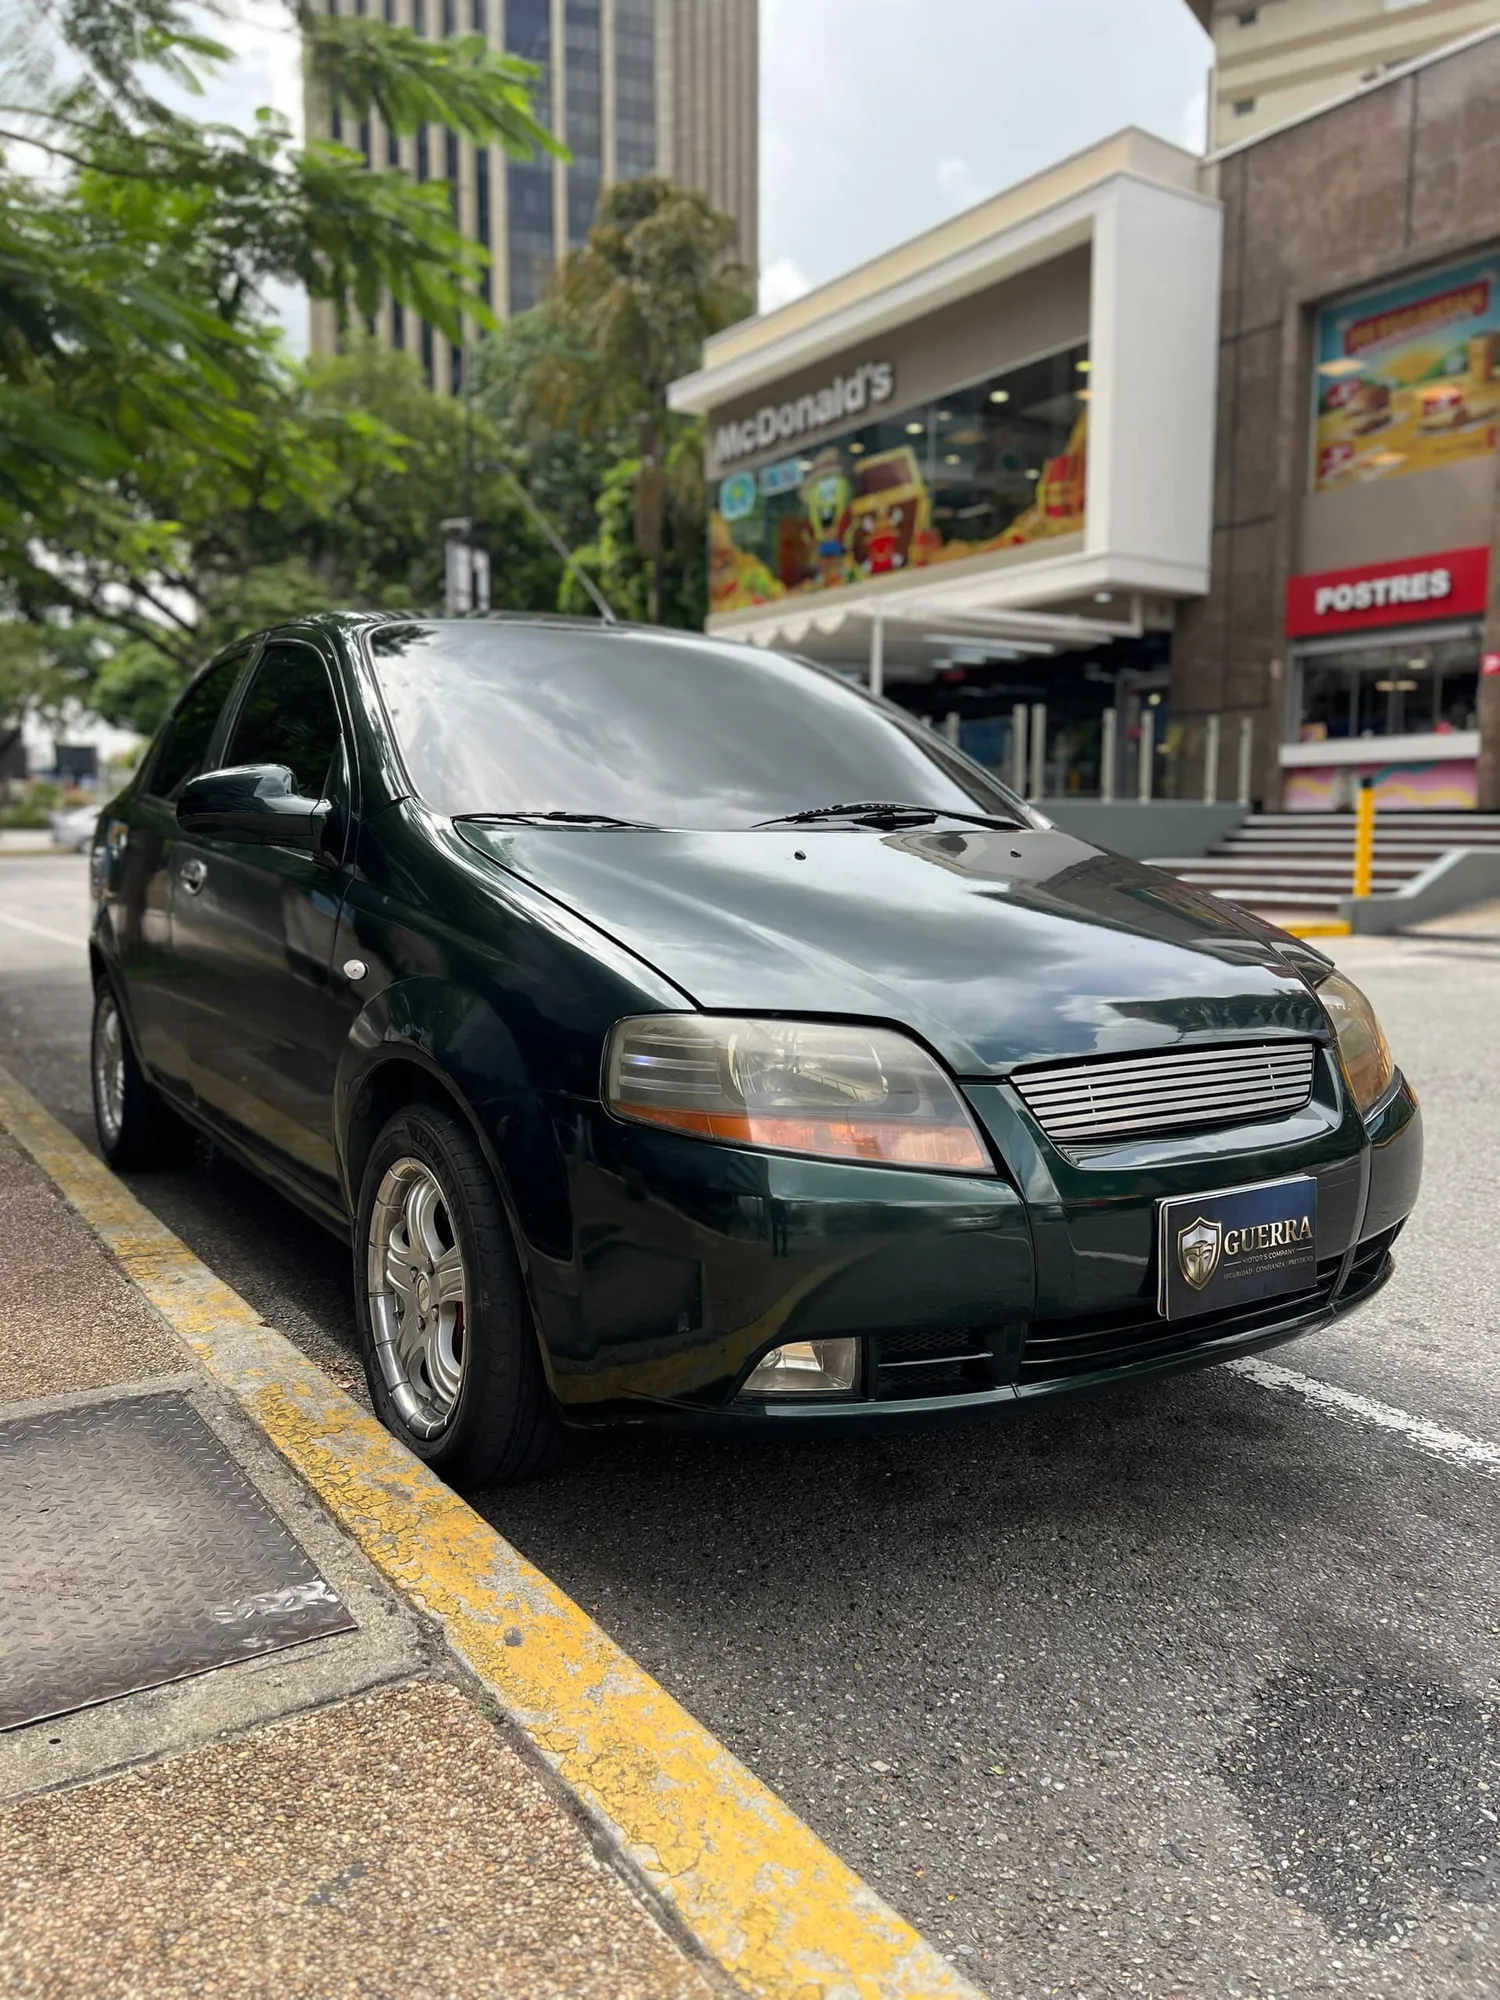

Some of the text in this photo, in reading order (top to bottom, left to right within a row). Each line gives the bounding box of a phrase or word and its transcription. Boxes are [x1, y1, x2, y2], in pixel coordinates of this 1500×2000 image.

[714, 361, 893, 461] McDonald's
[1315, 569, 1451, 614] POSTRES
[1224, 1216, 1313, 1255] GUERRA
[1268, 1248, 1295, 1260] COMPANY
[1256, 1262, 1285, 1273] CONFIANZA
